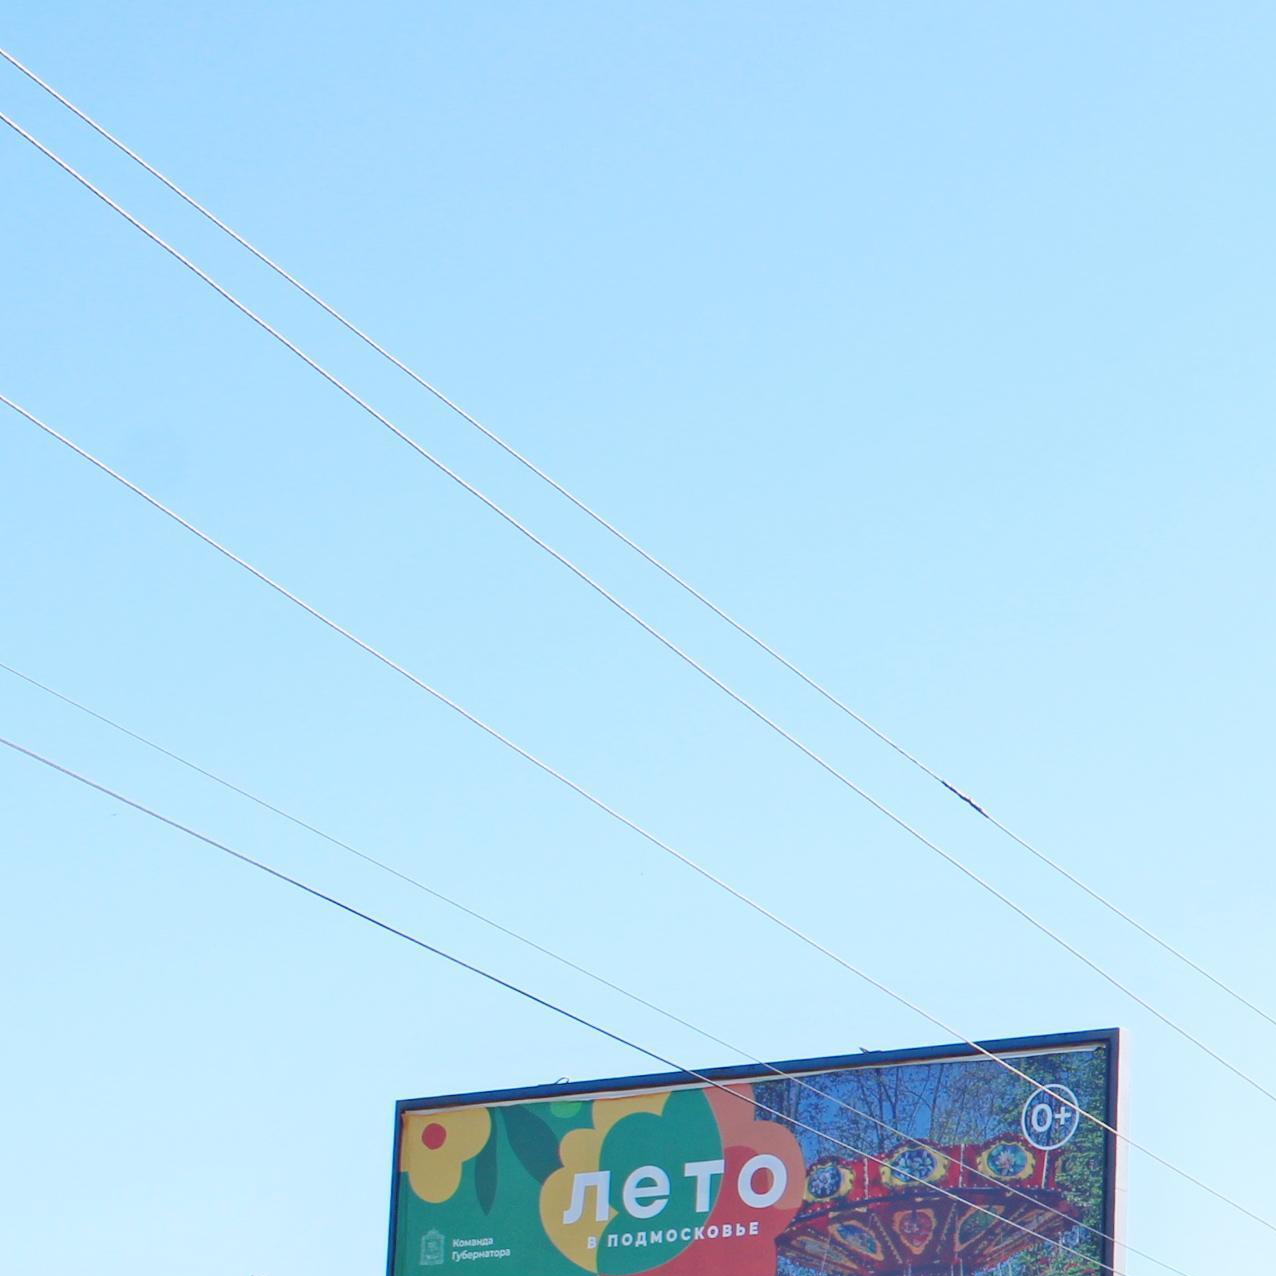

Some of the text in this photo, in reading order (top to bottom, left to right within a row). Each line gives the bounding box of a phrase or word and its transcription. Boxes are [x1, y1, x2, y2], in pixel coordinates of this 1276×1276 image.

[1031, 1103, 1072, 1133] 0+
[452, 1237, 494, 1248] Команда
[607, 1221, 760, 1248] ПОДМОСКОВЬЕ
[451, 1248, 511, 1262] Губернатора
